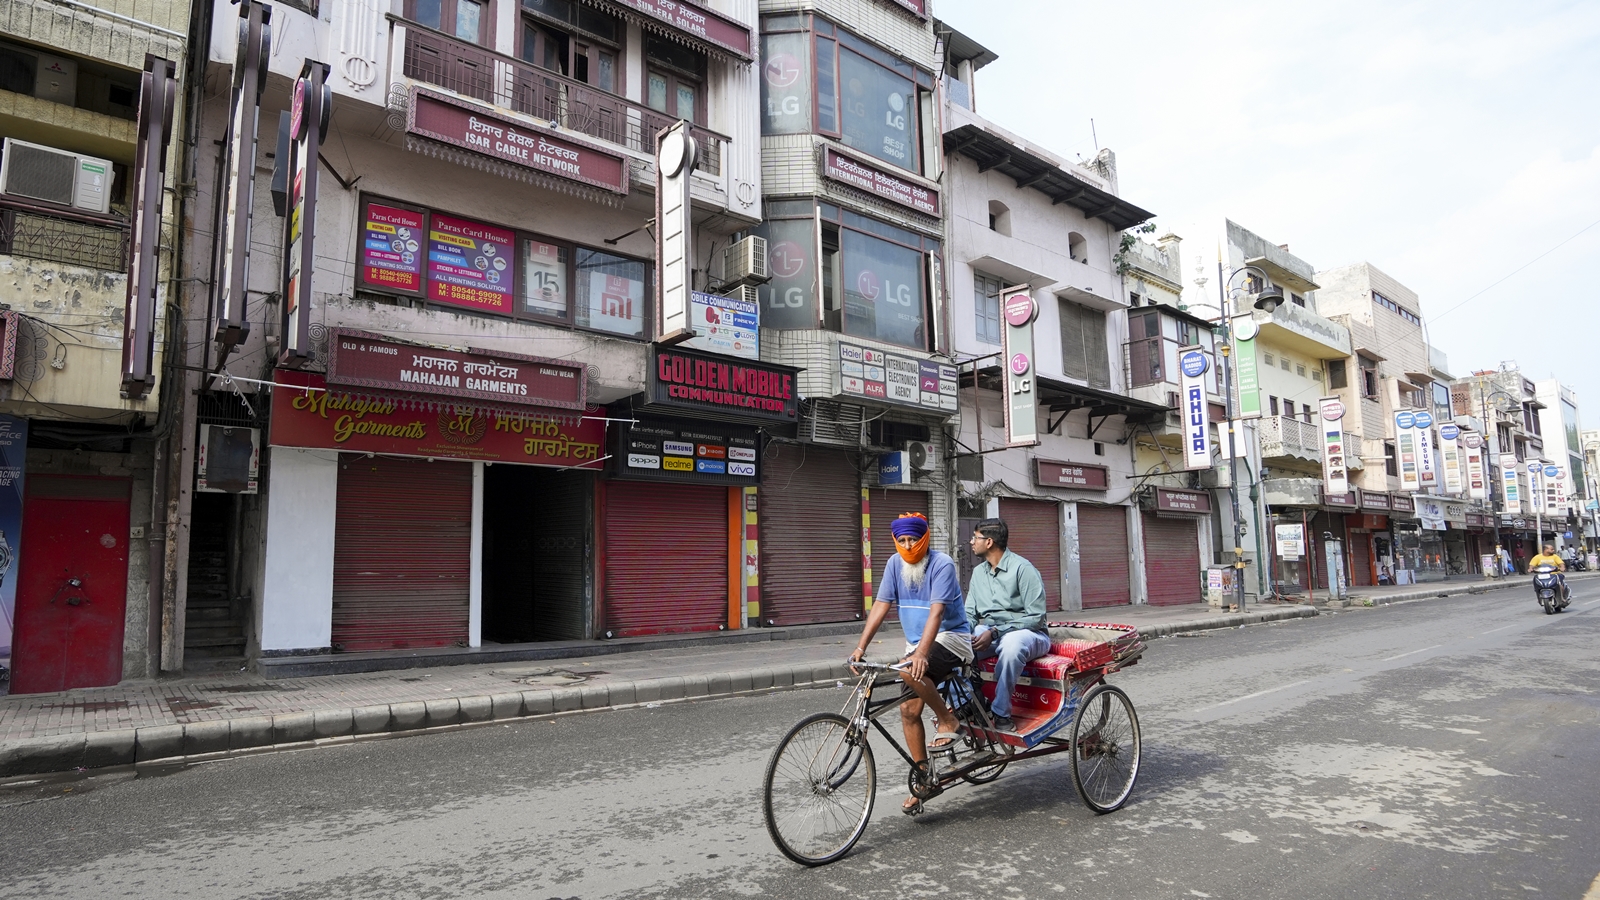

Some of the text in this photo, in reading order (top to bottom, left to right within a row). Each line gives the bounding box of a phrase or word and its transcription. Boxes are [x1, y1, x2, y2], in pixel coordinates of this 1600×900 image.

[636, 0, 706, 36] SUN-ERA SOLARS
[768, 96, 799, 116] LG
[468, 116, 504, 138] ਇਸਾਰ
[886, 110, 904, 130] LG
[884, 136, 904, 151] BEST
[465, 132, 581, 175] ISAR CABLE NETWORK
[883, 145, 904, 159] SHOP
[829, 166, 934, 212] INTERNATIONAL ELECTRONICS AGENCY
[372, 212, 418, 226] Paras Card House
[438, 221, 508, 244] Paras Card House
[438, 235, 457, 244] VISITING
[377, 261, 394, 269] PRINTING
[395, 263, 415, 271] SOLUTION
[437, 255, 461, 264] PAMPHLET
[458, 269, 482, 278] LETTERHEAD
[448, 276, 476, 287] PRINTING
[477, 280, 506, 292] SOLUTION
[534, 271, 559, 294] 15
[451, 292, 502, 306] 98886-57726
[452, 286, 502, 300] 80540-69092
[770, 288, 803, 308] LG
[886, 280, 910, 306] LG
[691, 293, 755, 314] OBILE COMMUNICATION
[369, 346, 398, 355] FAMOUS
[842, 348, 861, 358] Haier
[874, 354, 882, 363] LG
[886, 358, 918, 374] INTERNATIONAL
[412, 355, 518, 379] ਮਹਾਜਨ ਗਾਰਮੈਂਟਸ
[540, 368, 558, 376] FAMILY
[921, 365, 938, 374] Panasonic
[400, 370, 527, 395] MAHAJAN GARMENTS
[658, 354, 791, 400] GOLDEN MOBILE
[888, 372, 916, 387] ELECTRONICS
[866, 384, 884, 393] ALFA
[895, 385, 911, 398] AGENCY
[1012, 379, 1030, 394] LG
[669, 385, 784, 412] COMMUNICATION
[1189, 388, 1205, 451] AHUJA
[334, 415, 426, 442] Garments
[524, 434, 600, 460] ਗਾਰਮੈਂਟਸ
[637, 442, 656, 450] iPhone
[664, 444, 692, 452] SAMSUNG
[1421, 431, 1429, 470] SAMSUNG
[665, 460, 692, 469] realme
[730, 465, 753, 474] vivo
[882, 465, 899, 473] Haier
